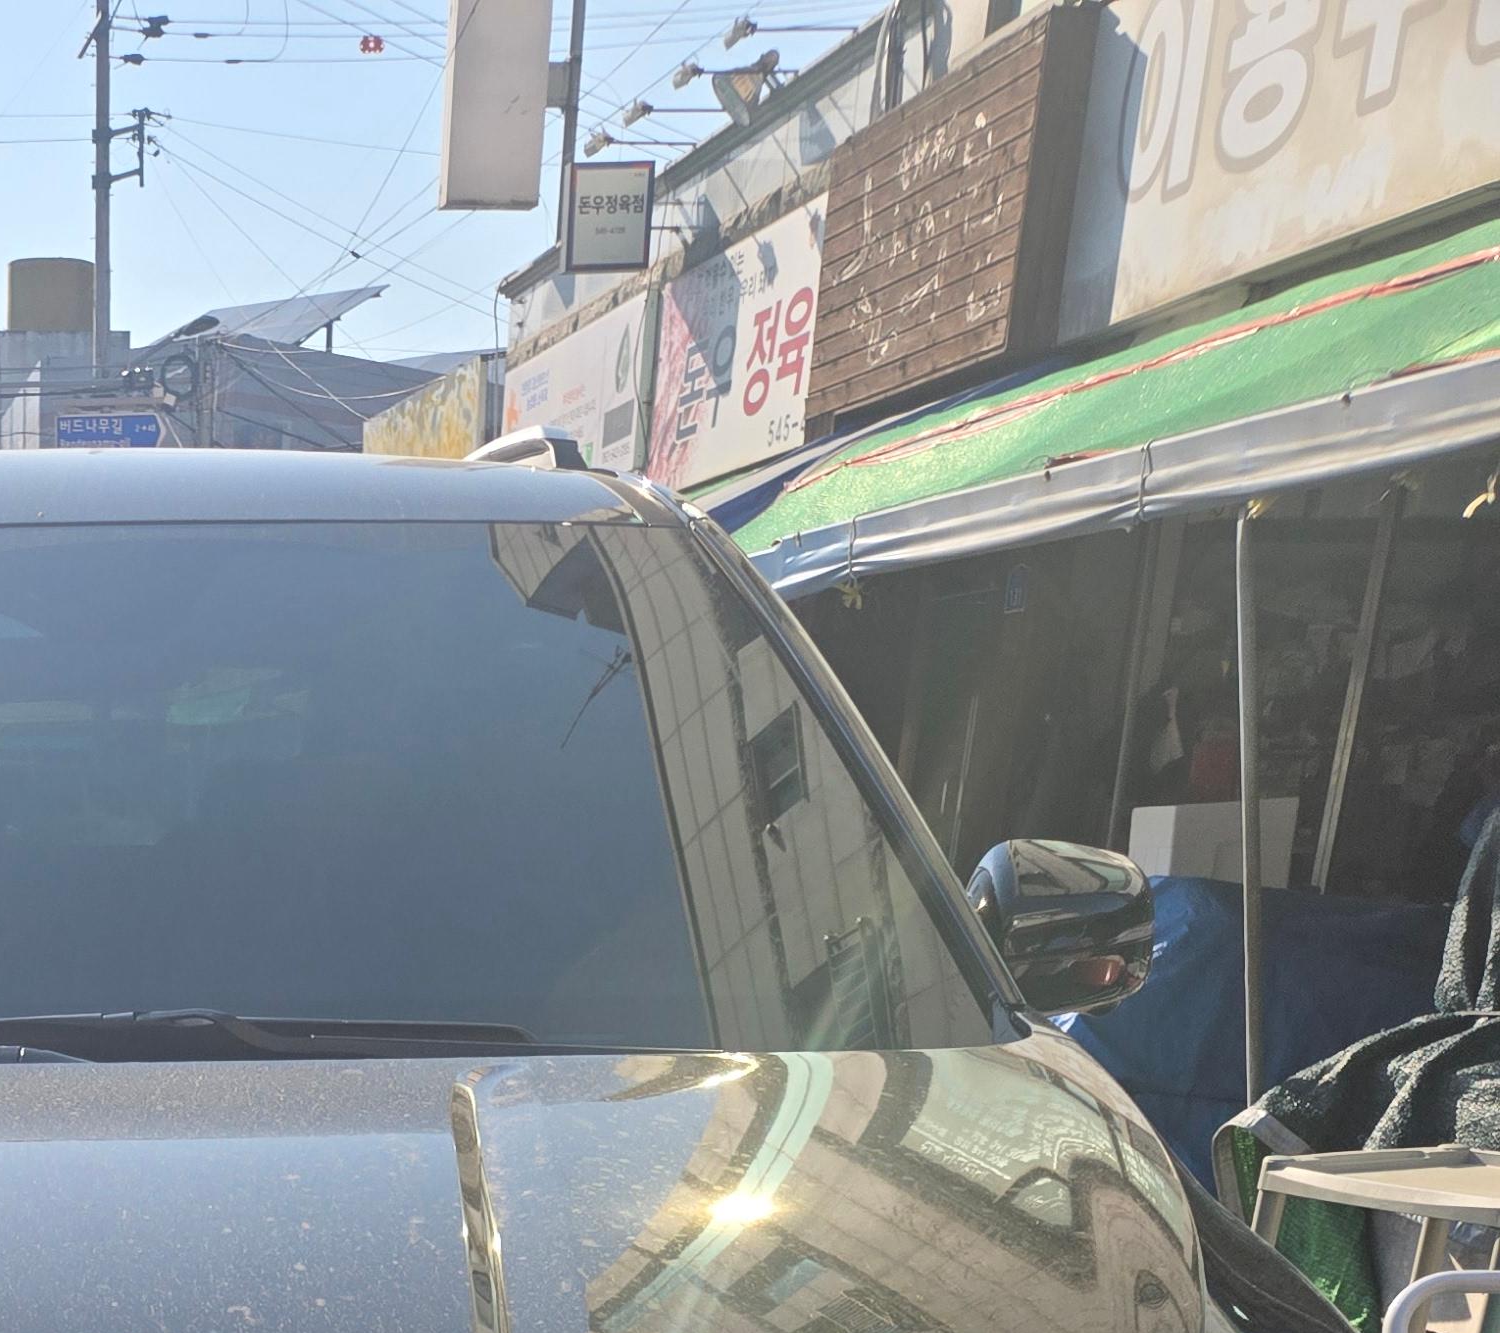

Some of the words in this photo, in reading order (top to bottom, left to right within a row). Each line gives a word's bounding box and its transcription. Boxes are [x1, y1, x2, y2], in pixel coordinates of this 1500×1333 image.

[577, 193, 645, 215] 돈우정육점
[676, 325, 735, 441] 돈우
[743, 287, 814, 416] 정육
[60, 418, 123, 434] 버드나무길
